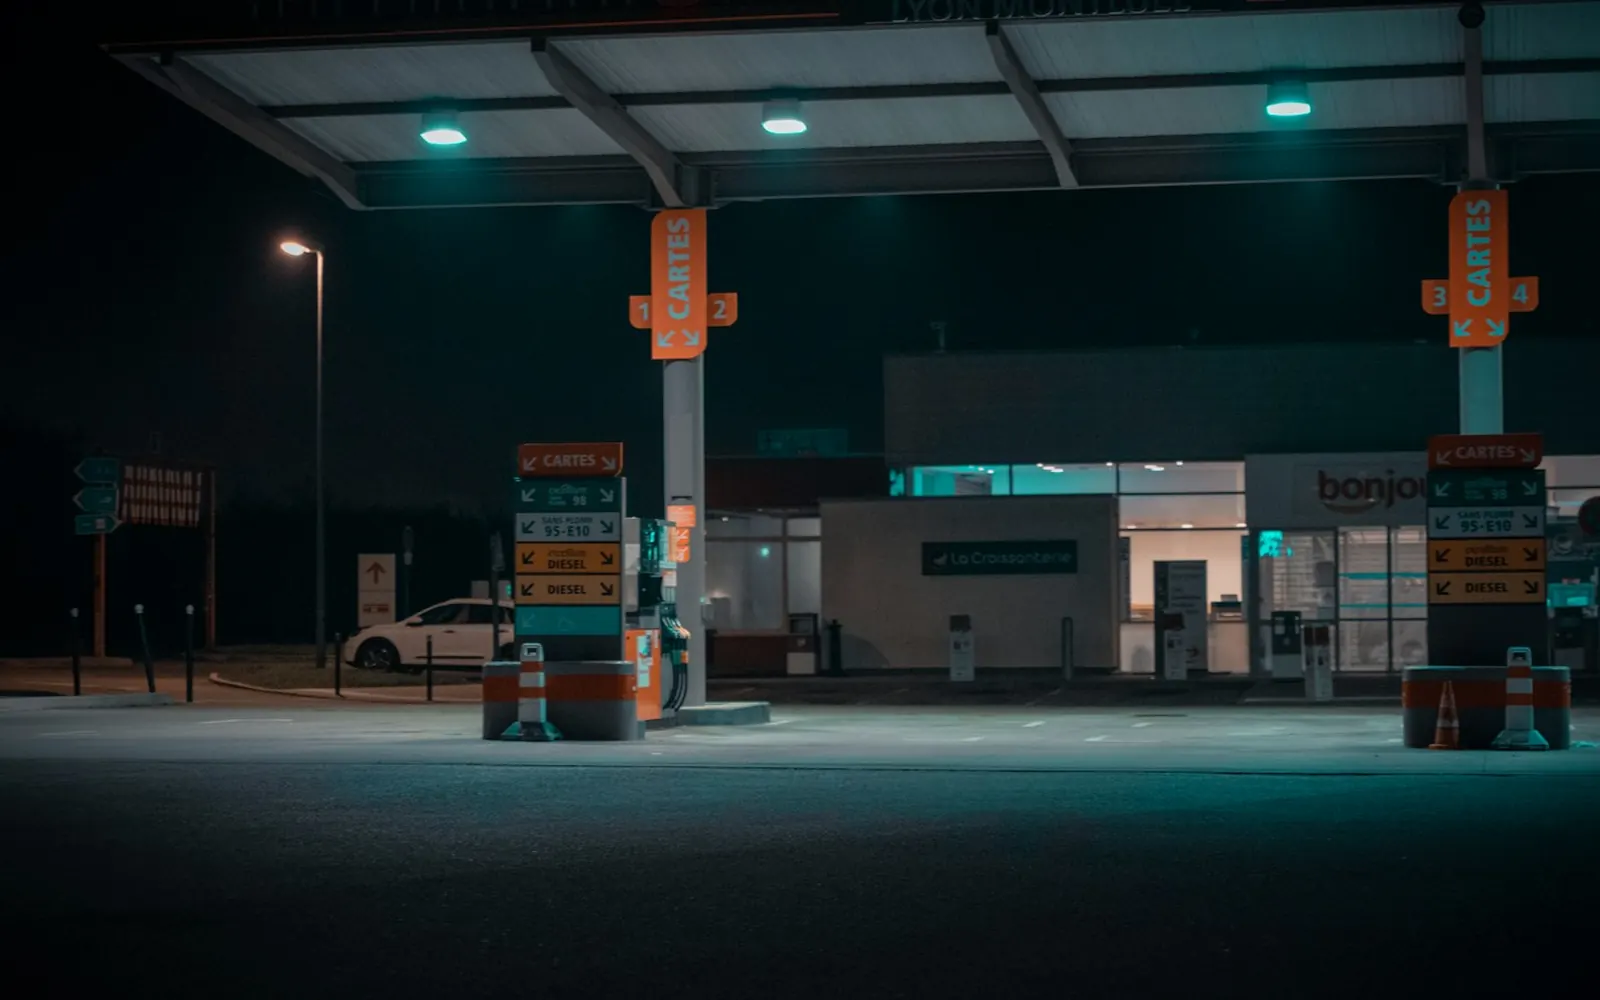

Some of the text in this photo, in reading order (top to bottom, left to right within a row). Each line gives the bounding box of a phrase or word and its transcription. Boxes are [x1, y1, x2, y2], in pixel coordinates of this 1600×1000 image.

[892, 0, 980, 22] LYON
[1466, 199, 1492, 307] CARTES
[667, 217, 690, 320] CARTES
[1433, 286, 1447, 307] 3
[1512, 283, 1528, 304] 4
[639, 302, 649, 321] 1
[712, 299, 727, 320] 2
[1456, 446, 1516, 460] CARTES
[543, 453, 596, 468] CARTES
[572, 495, 588, 506] 98
[545, 525, 590, 537] 95-E10
[1461, 520, 1512, 532] 95-E10
[547, 560, 587, 570] DIESEL
[951, 552, 969, 565] La
[1465, 556, 1509, 567] DIESEL
[547, 584, 587, 595] DIESEL
[1465, 582, 1509, 593] DIESEL
